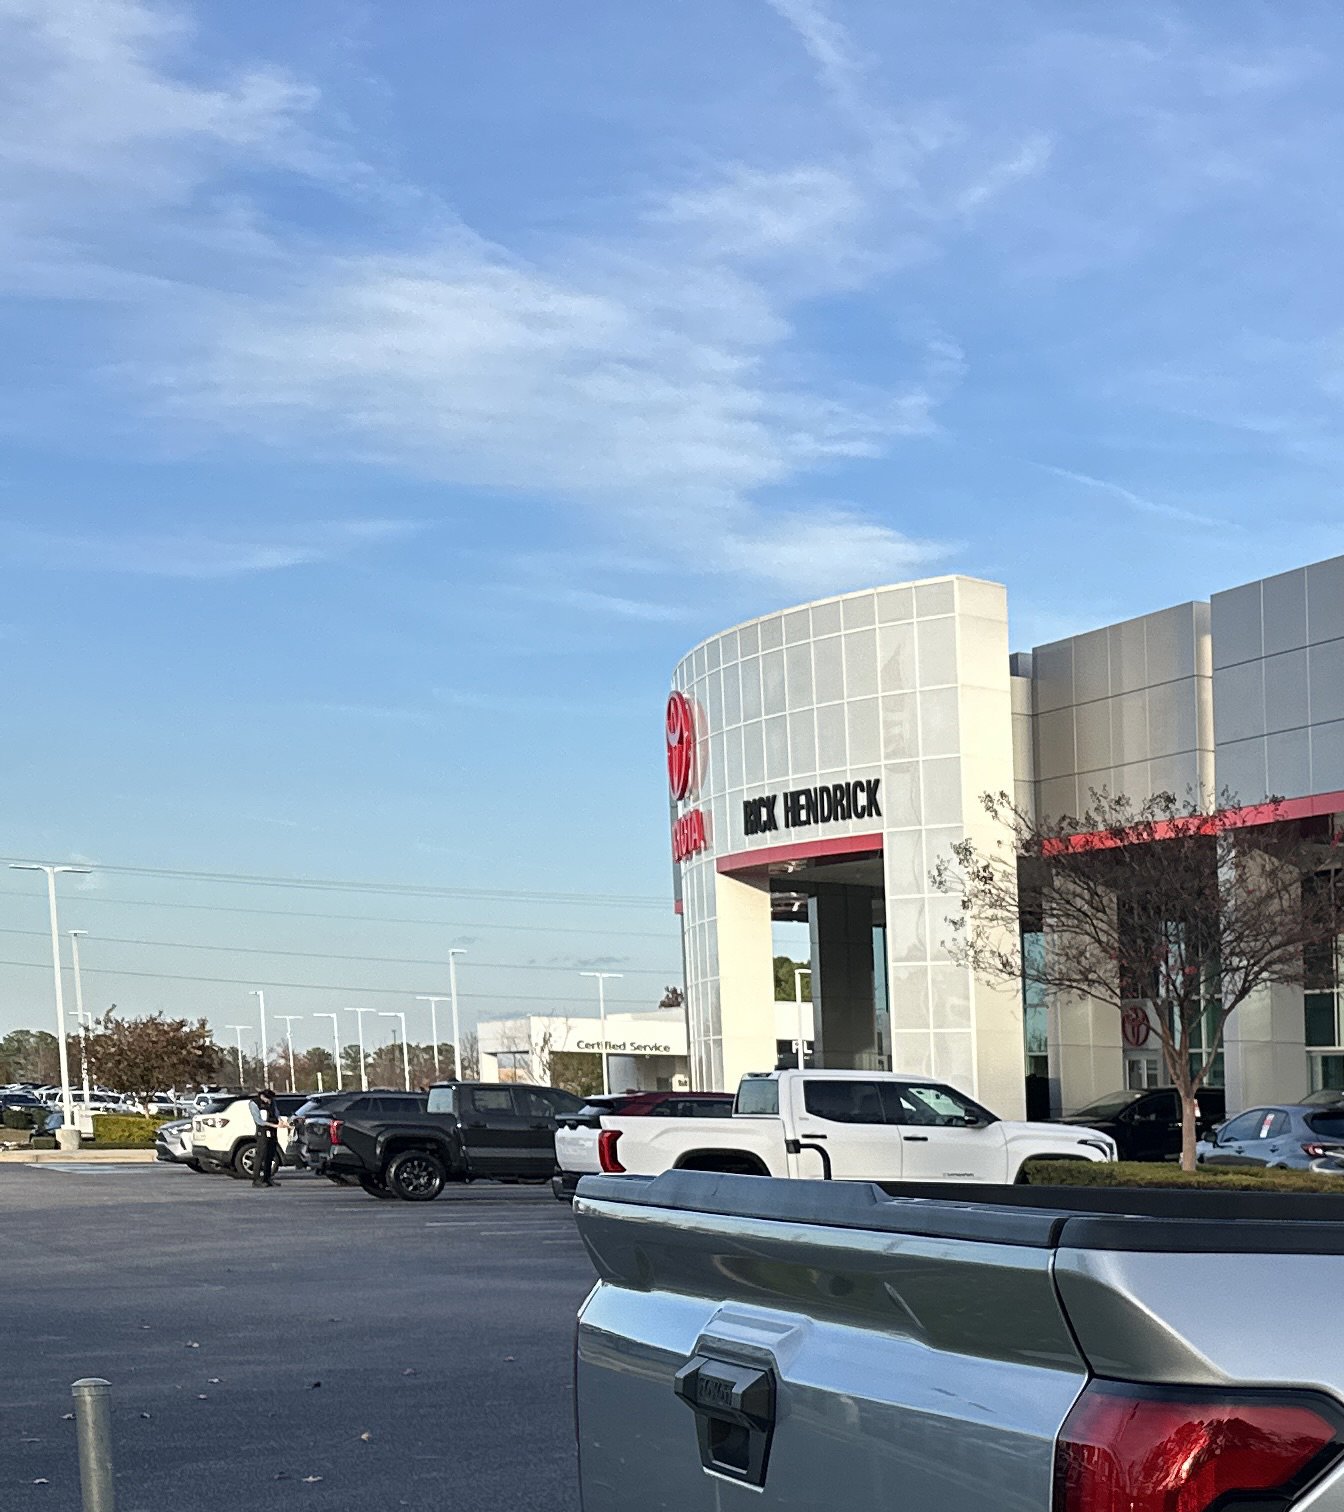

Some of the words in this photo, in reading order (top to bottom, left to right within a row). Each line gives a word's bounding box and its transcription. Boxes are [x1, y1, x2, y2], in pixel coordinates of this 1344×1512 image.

[743, 794, 778, 835] RICK
[783, 778, 882, 828] HENDRICK
[577, 1040, 627, 1051] Certified
[630, 1042, 671, 1052] Service
